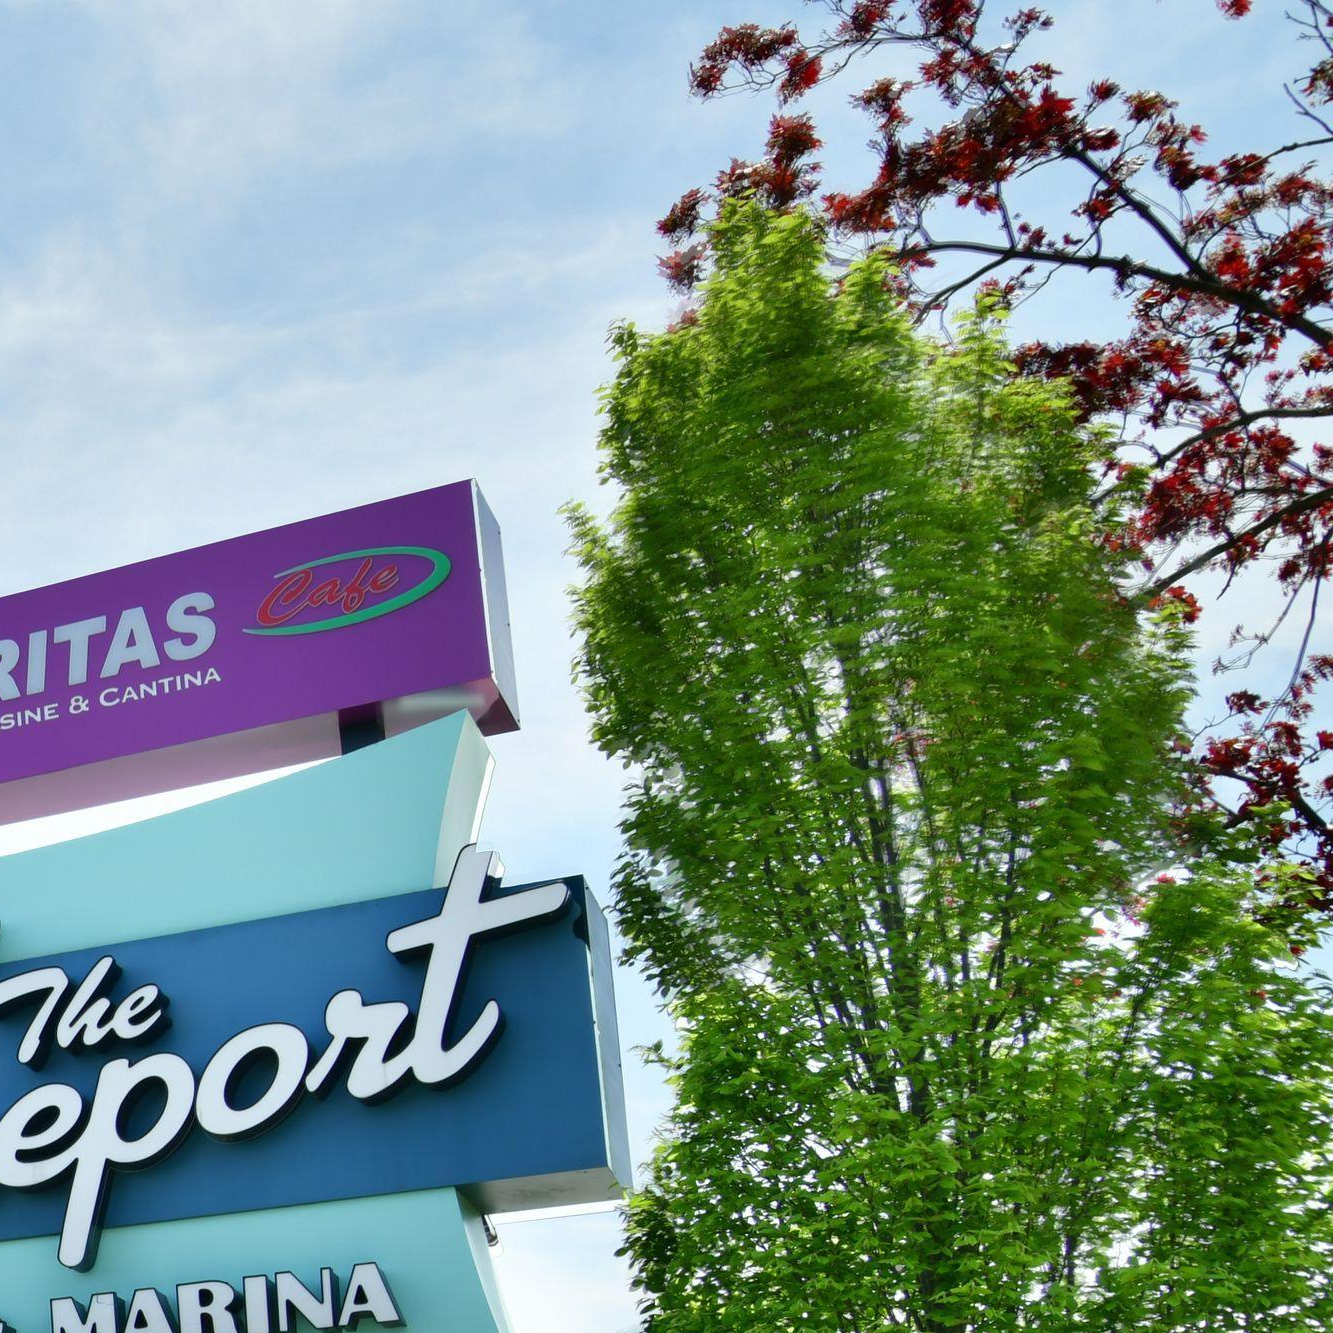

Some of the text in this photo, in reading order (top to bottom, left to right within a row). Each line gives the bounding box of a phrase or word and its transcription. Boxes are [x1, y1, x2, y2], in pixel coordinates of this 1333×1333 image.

[256, 556, 400, 624] Cafe
[68, 695, 90, 715] &
[98, 666, 222, 707] CANTINA
